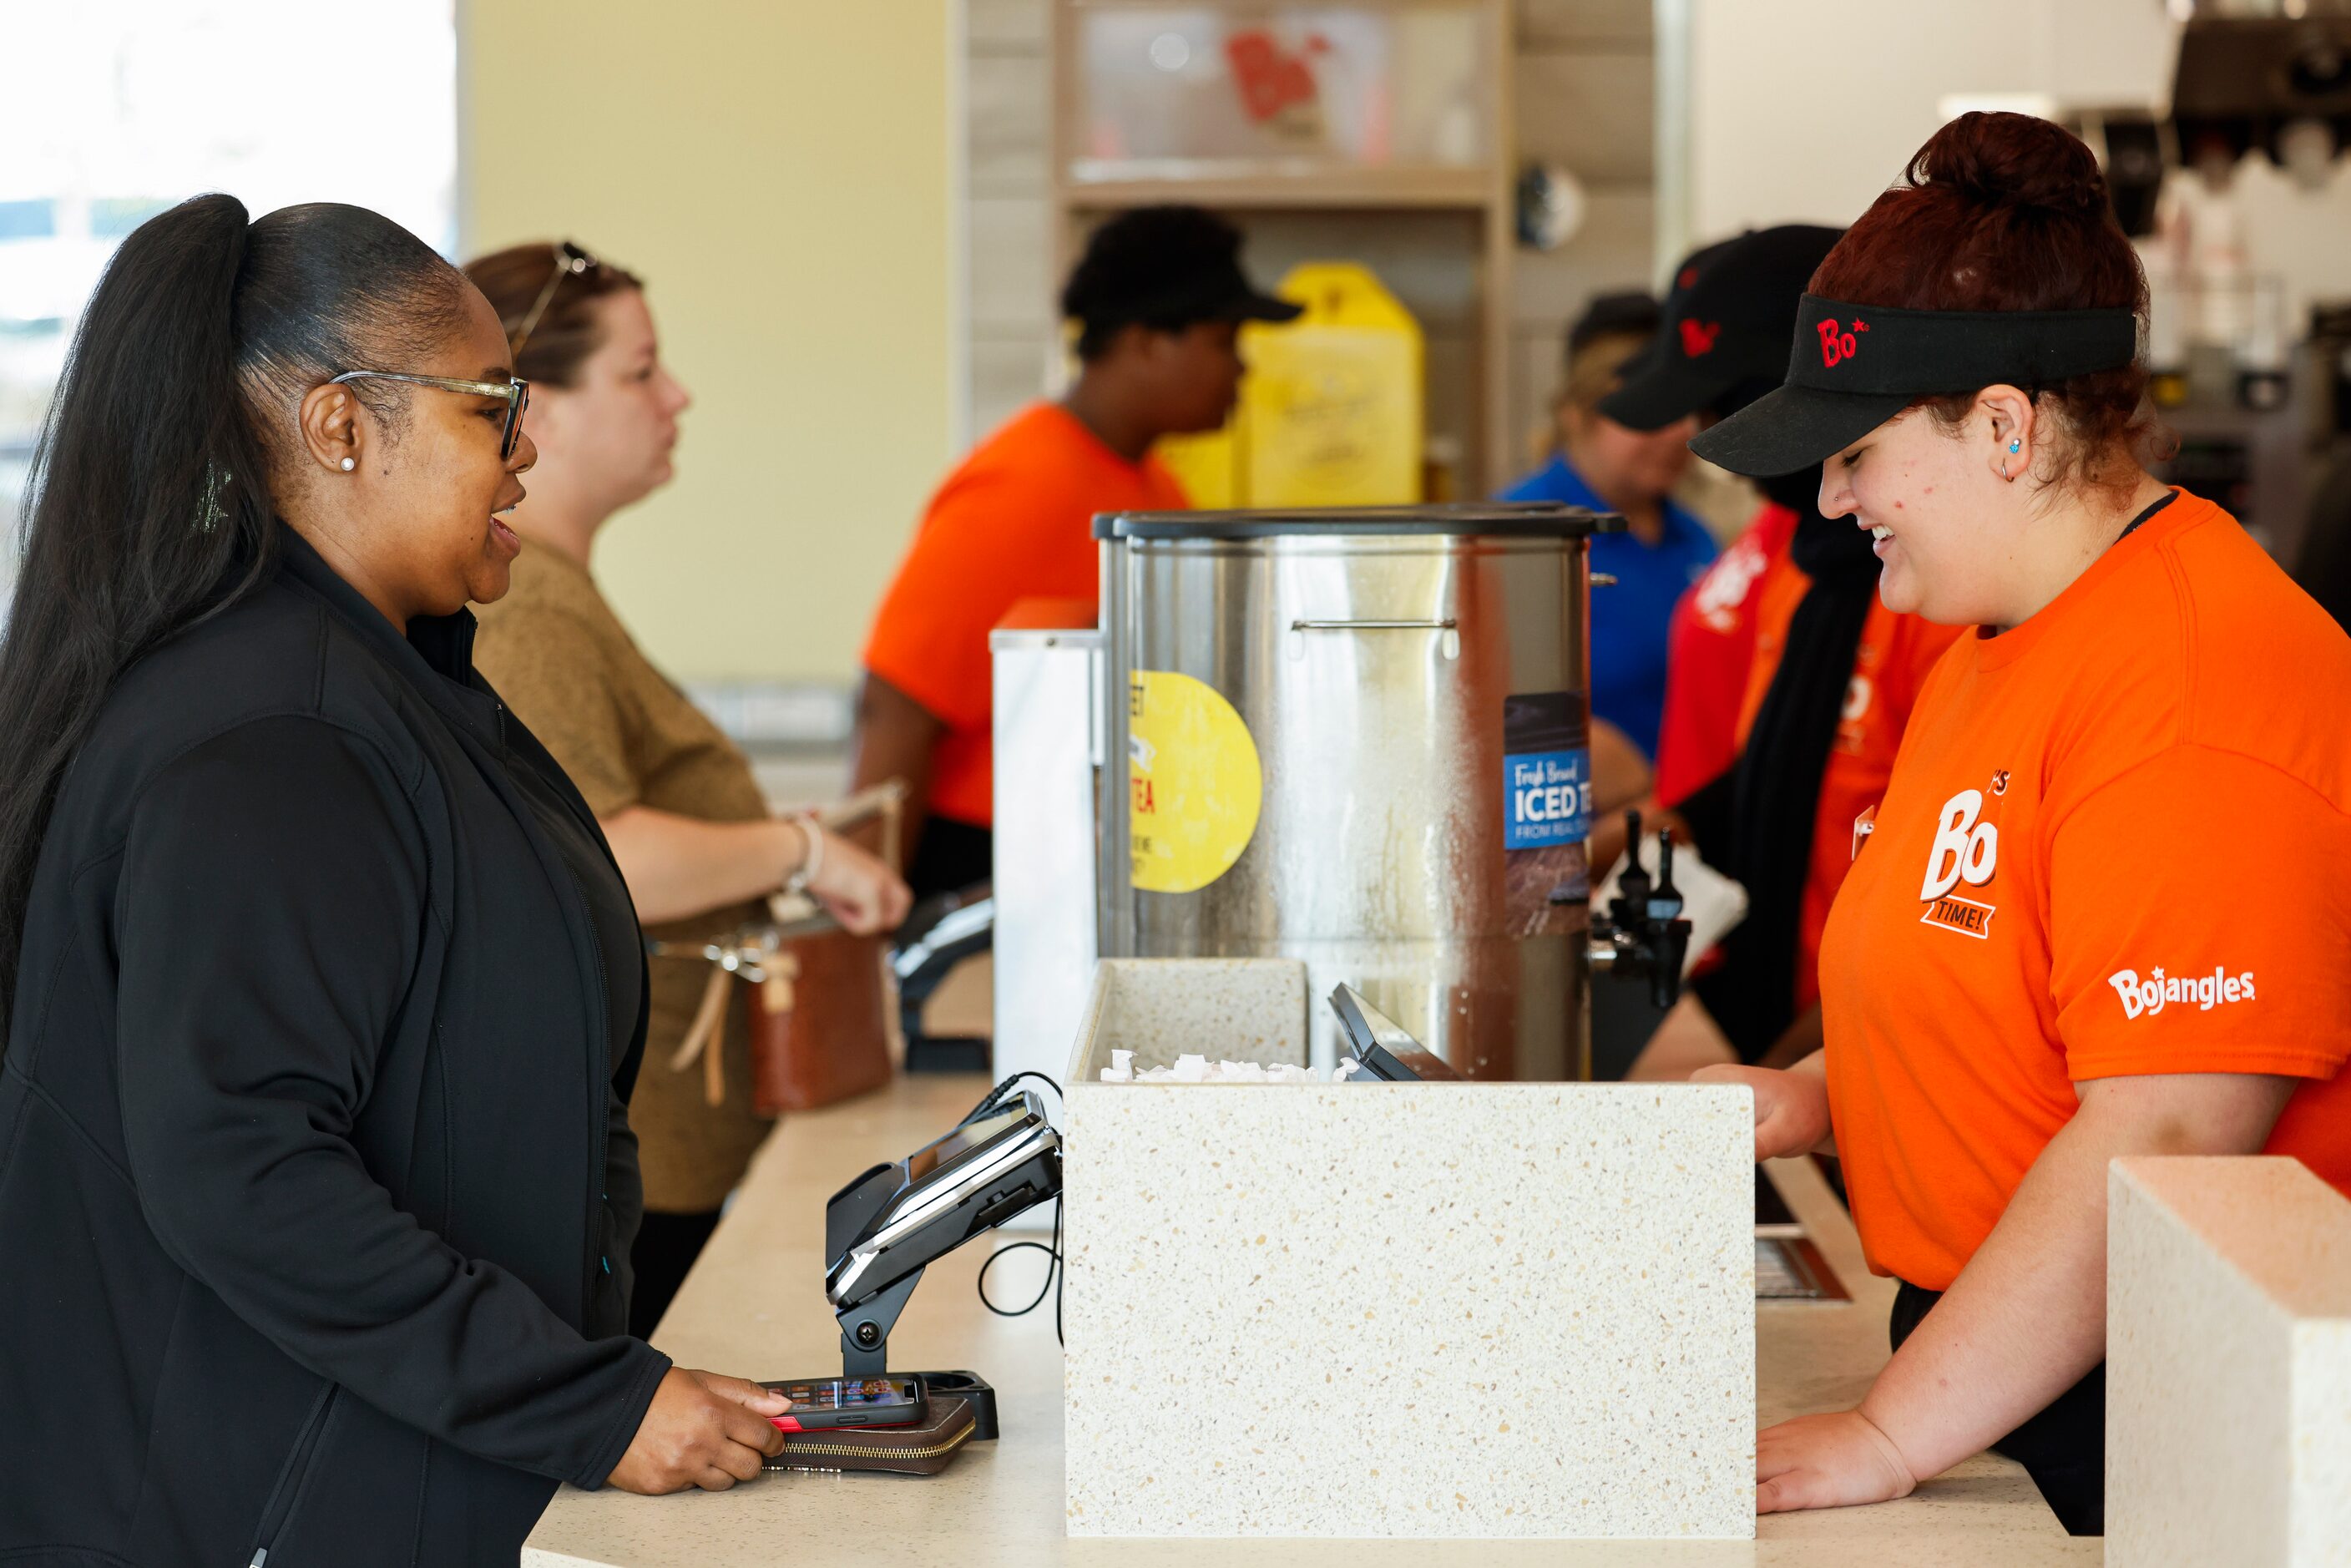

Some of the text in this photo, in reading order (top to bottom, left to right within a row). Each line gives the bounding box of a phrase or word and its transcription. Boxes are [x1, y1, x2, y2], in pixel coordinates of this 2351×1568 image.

[1817, 318, 1857, 368] Bo
[1514, 785, 1577, 822] ICED
[1919, 788, 1998, 903] Bo
[1937, 899, 1984, 930] TIME!
[2107, 965, 2256, 1020] Bojangles
